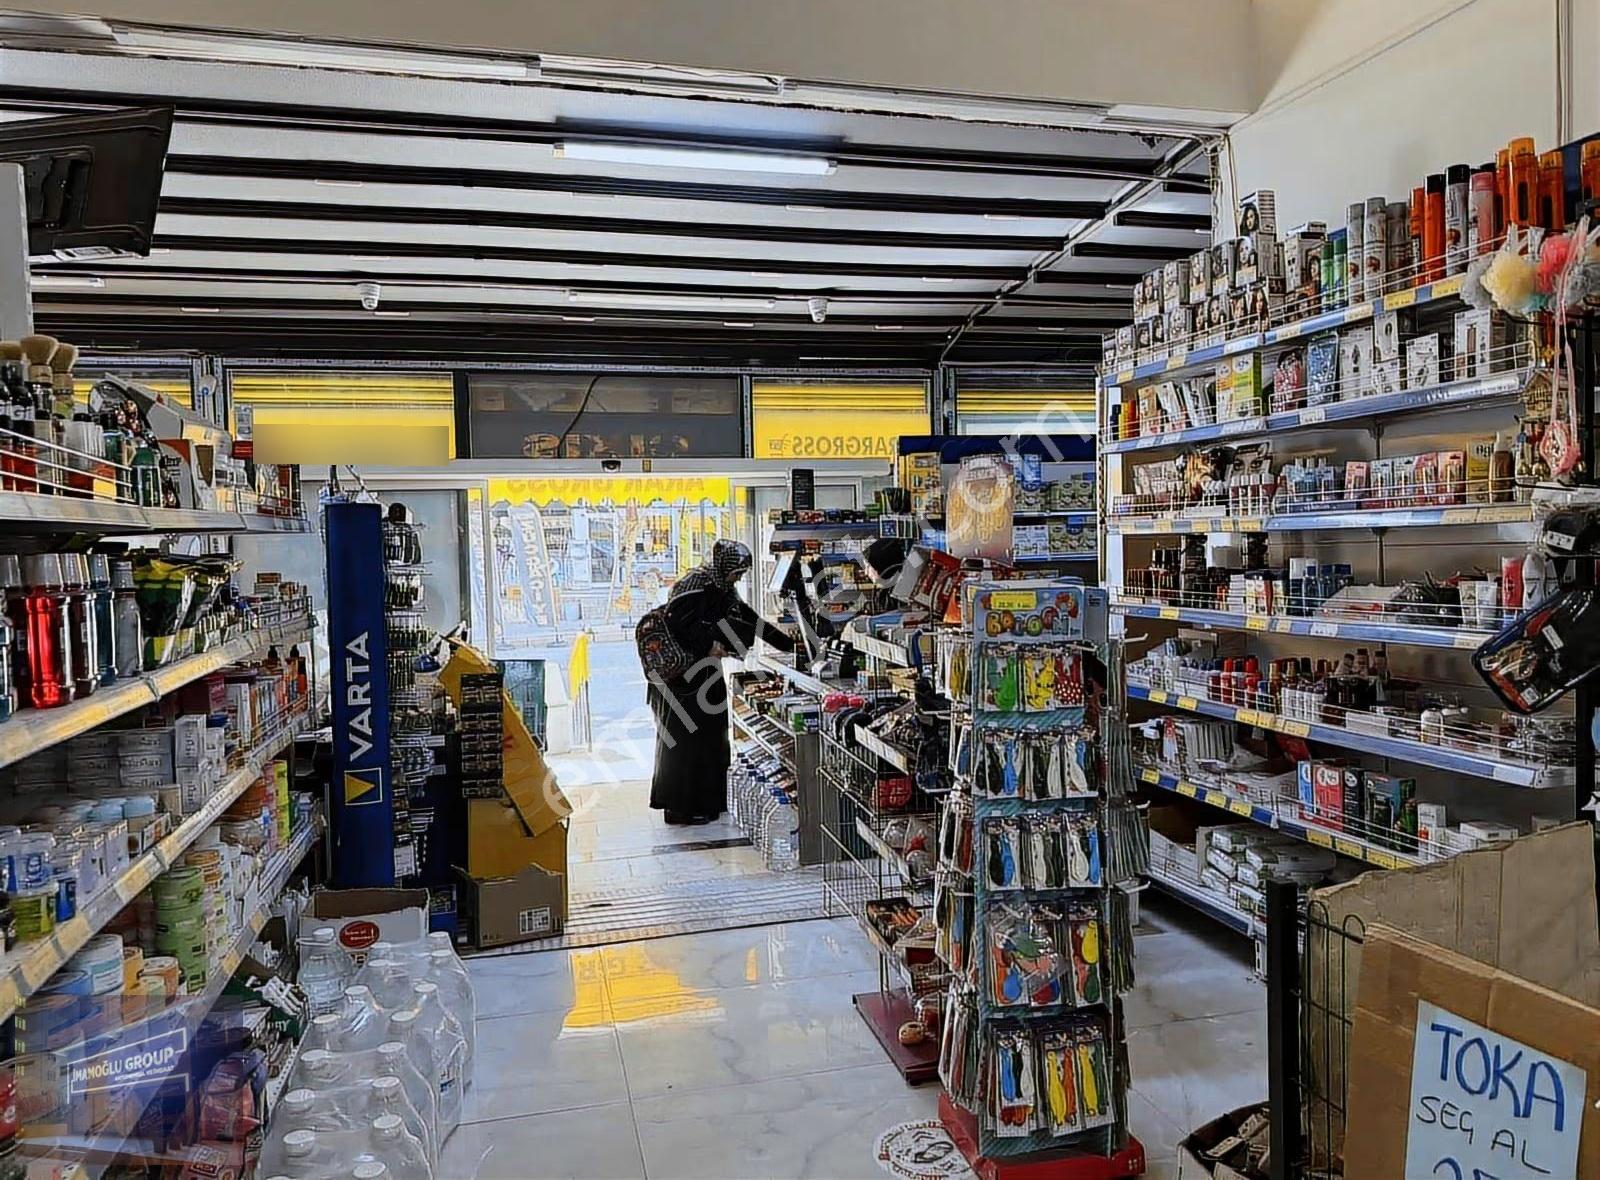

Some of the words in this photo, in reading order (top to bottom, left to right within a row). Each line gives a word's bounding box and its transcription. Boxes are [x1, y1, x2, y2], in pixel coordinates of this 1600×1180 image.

[345, 631, 373, 762] VARTA
[1430, 1023, 1565, 1132] TOKA
[1491, 1129, 1551, 1174] AL
